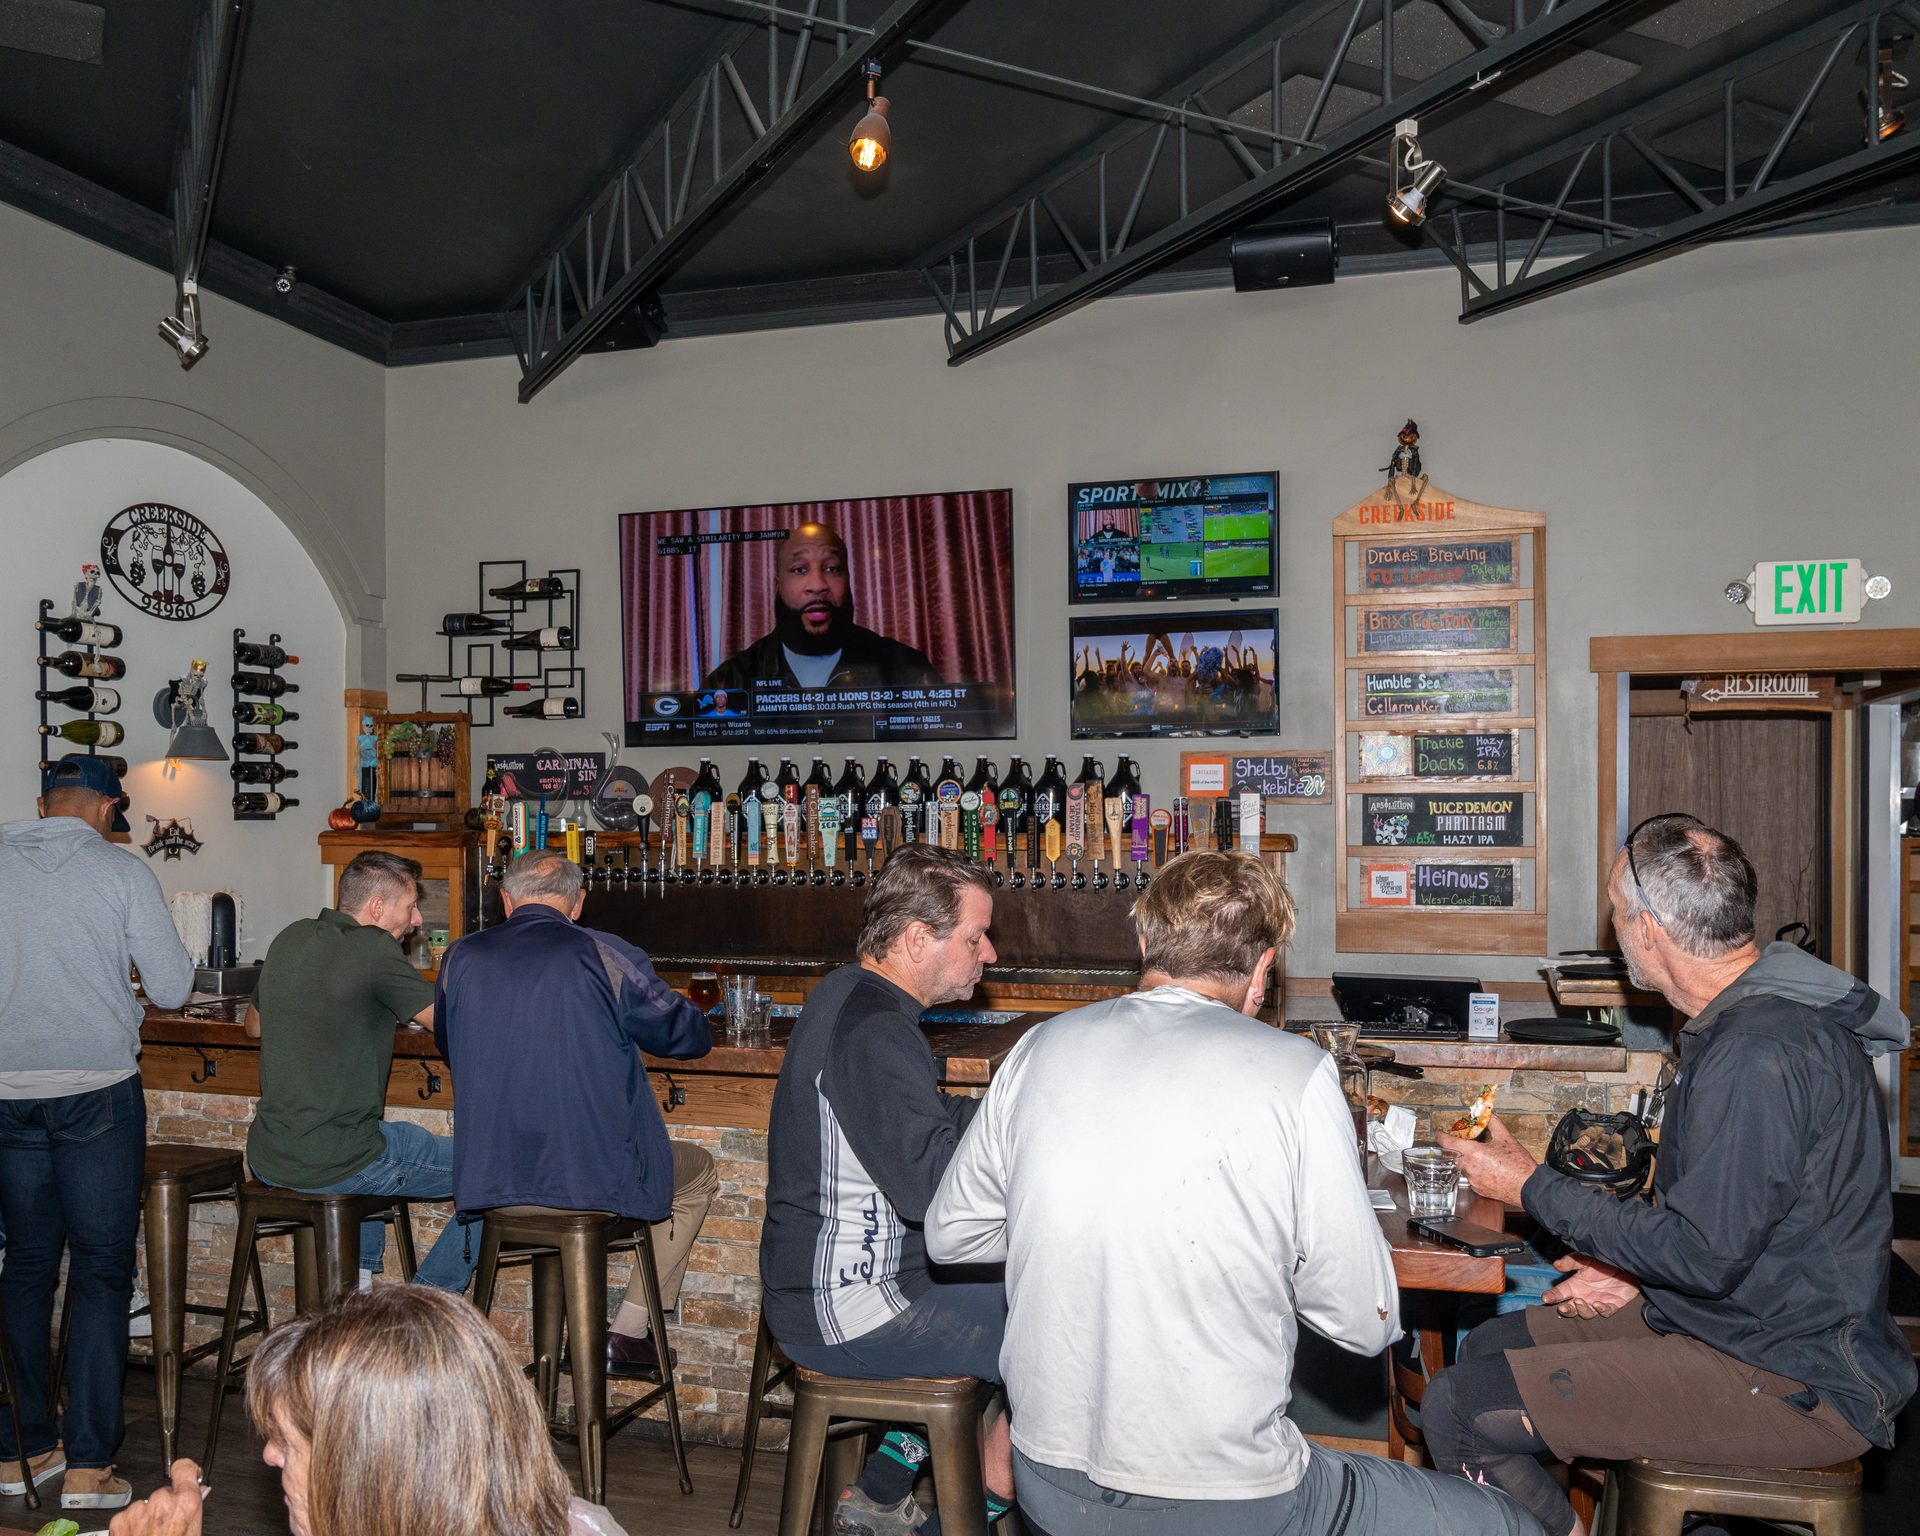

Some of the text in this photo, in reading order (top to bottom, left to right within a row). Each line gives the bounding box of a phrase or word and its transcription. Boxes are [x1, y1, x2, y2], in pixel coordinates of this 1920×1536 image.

[1077, 484, 1146, 504] SPORT
[1359, 501, 1456, 524] CREEKSIDE
[128, 506, 208, 541] CREEKSIDE
[696, 533, 741, 543] SIMILARITY
[758, 531, 786, 539] JAHMYR
[657, 547, 684, 555] GIBBS,
[1367, 546, 1486, 565] Drake's Brewing
[1774, 562, 1848, 615] EXIT
[141, 594, 196, 619] 94960
[1368, 612, 1405, 632] Brix
[768, 679, 782, 687] LIVE
[1366, 674, 1412, 691] Humble
[1418, 673, 1442, 690] Sea
[1724, 672, 1809, 694] RESTROOM
[755, 689, 967, 704] PACKERS (4-2) at LIONS (3-2) SUN. 4:25 ET
[756, 704, 788, 712] JAHMYR
[789, 703, 815, 711] GIBBS:
[816, 702, 836, 711] 100.8
[837, 702, 853, 710] Rush
[855, 702, 872, 710] YPG
[914, 700, 930, 709] (4th
[930, 700, 938, 708] in
[938, 699, 957, 708] NFL)
[1367, 697, 1440, 715] Cellarmaker
[645, 723, 670, 731] ESPN
[695, 722, 718, 730] Raptors
[1415, 737, 1465, 751] Trackie
[1475, 736, 1504, 750] Hazy
[1476, 746, 1501, 757] IPA
[1235, 758, 1289, 779] Shelby
[1419, 753, 1465, 772] Dacks
[1477, 759, 1499, 771] 6.8%
[578, 769, 598, 782] SIN
[664, 785, 675, 837] Cellarmaker
[1370, 798, 1414, 812] ABSOLUTION
[1428, 800, 1513, 816] JUICE DEMON
[169, 826, 180, 836] Eat
[809, 800, 819, 855] Cellarmaker
[821, 821, 837, 829] SEA
[1437, 815, 1506, 832] PHANTASM
[147, 839, 165, 854] Drink
[164, 835, 176, 845] and
[176, 836, 184, 844] be
[1027, 815, 1035, 867] FIELDWORK
[1443, 834, 1495, 845] HAZY IPA
[1418, 865, 1489, 890] Heinous
[1481, 894, 1503, 905] IPA
[1473, 1005, 1495, 1013] Google
